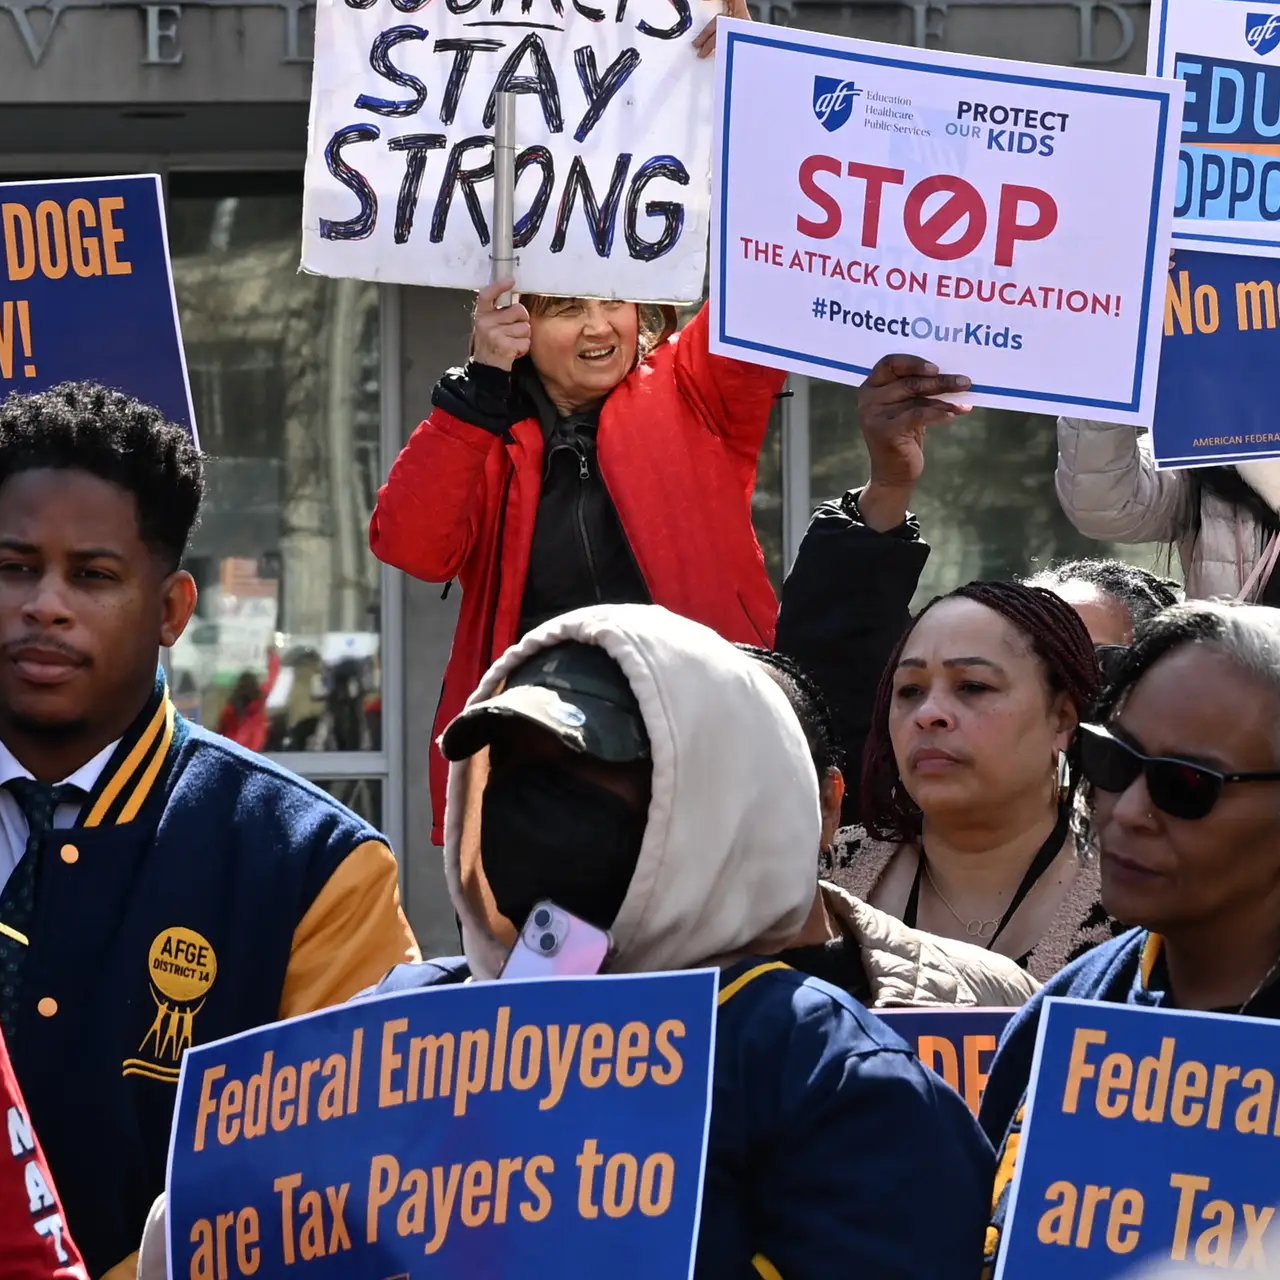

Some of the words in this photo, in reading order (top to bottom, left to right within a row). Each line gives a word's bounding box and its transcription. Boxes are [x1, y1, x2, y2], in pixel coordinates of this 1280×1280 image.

[354, 24, 642, 143] STAY
[865, 105, 914, 121] Healthcare
[867, 90, 912, 106] Education
[864, 119, 893, 132] Public
[893, 122, 931, 137] Services
[945, 122, 981, 138] OUR
[987, 128, 1055, 157] KIDS
[957, 100, 1069, 132] PROTECT
[320, 123, 690, 262] STRONG
[796, 154, 1059, 266] STOP
[3, 197, 132, 281] DOGE
[740, 237, 784, 267] THE
[789, 250, 880, 287] ATTACK
[885, 268, 928, 295] ON
[936, 274, 1122, 317] EDUCATION!
[1164, 270, 1219, 336] No
[812, 296, 1024, 351] #ProtectOurKids
[1192, 435, 1243, 447] AMERICAN
[153, 958, 196, 979] DISTRICT
[198, 971, 210, 983] 14
[160, 936, 209, 967] AFGE
[194, 1028, 363, 1152] Federal
[378, 1006, 686, 1117] Employees
[189, 1204, 260, 1280] are
[274, 1172, 350, 1266] Tax
[366, 1154, 554, 1255] Payers
[576, 1138, 675, 1220] too
[1037, 1180, 1144, 1255] are
[1169, 1173, 1275, 1267] Tax
